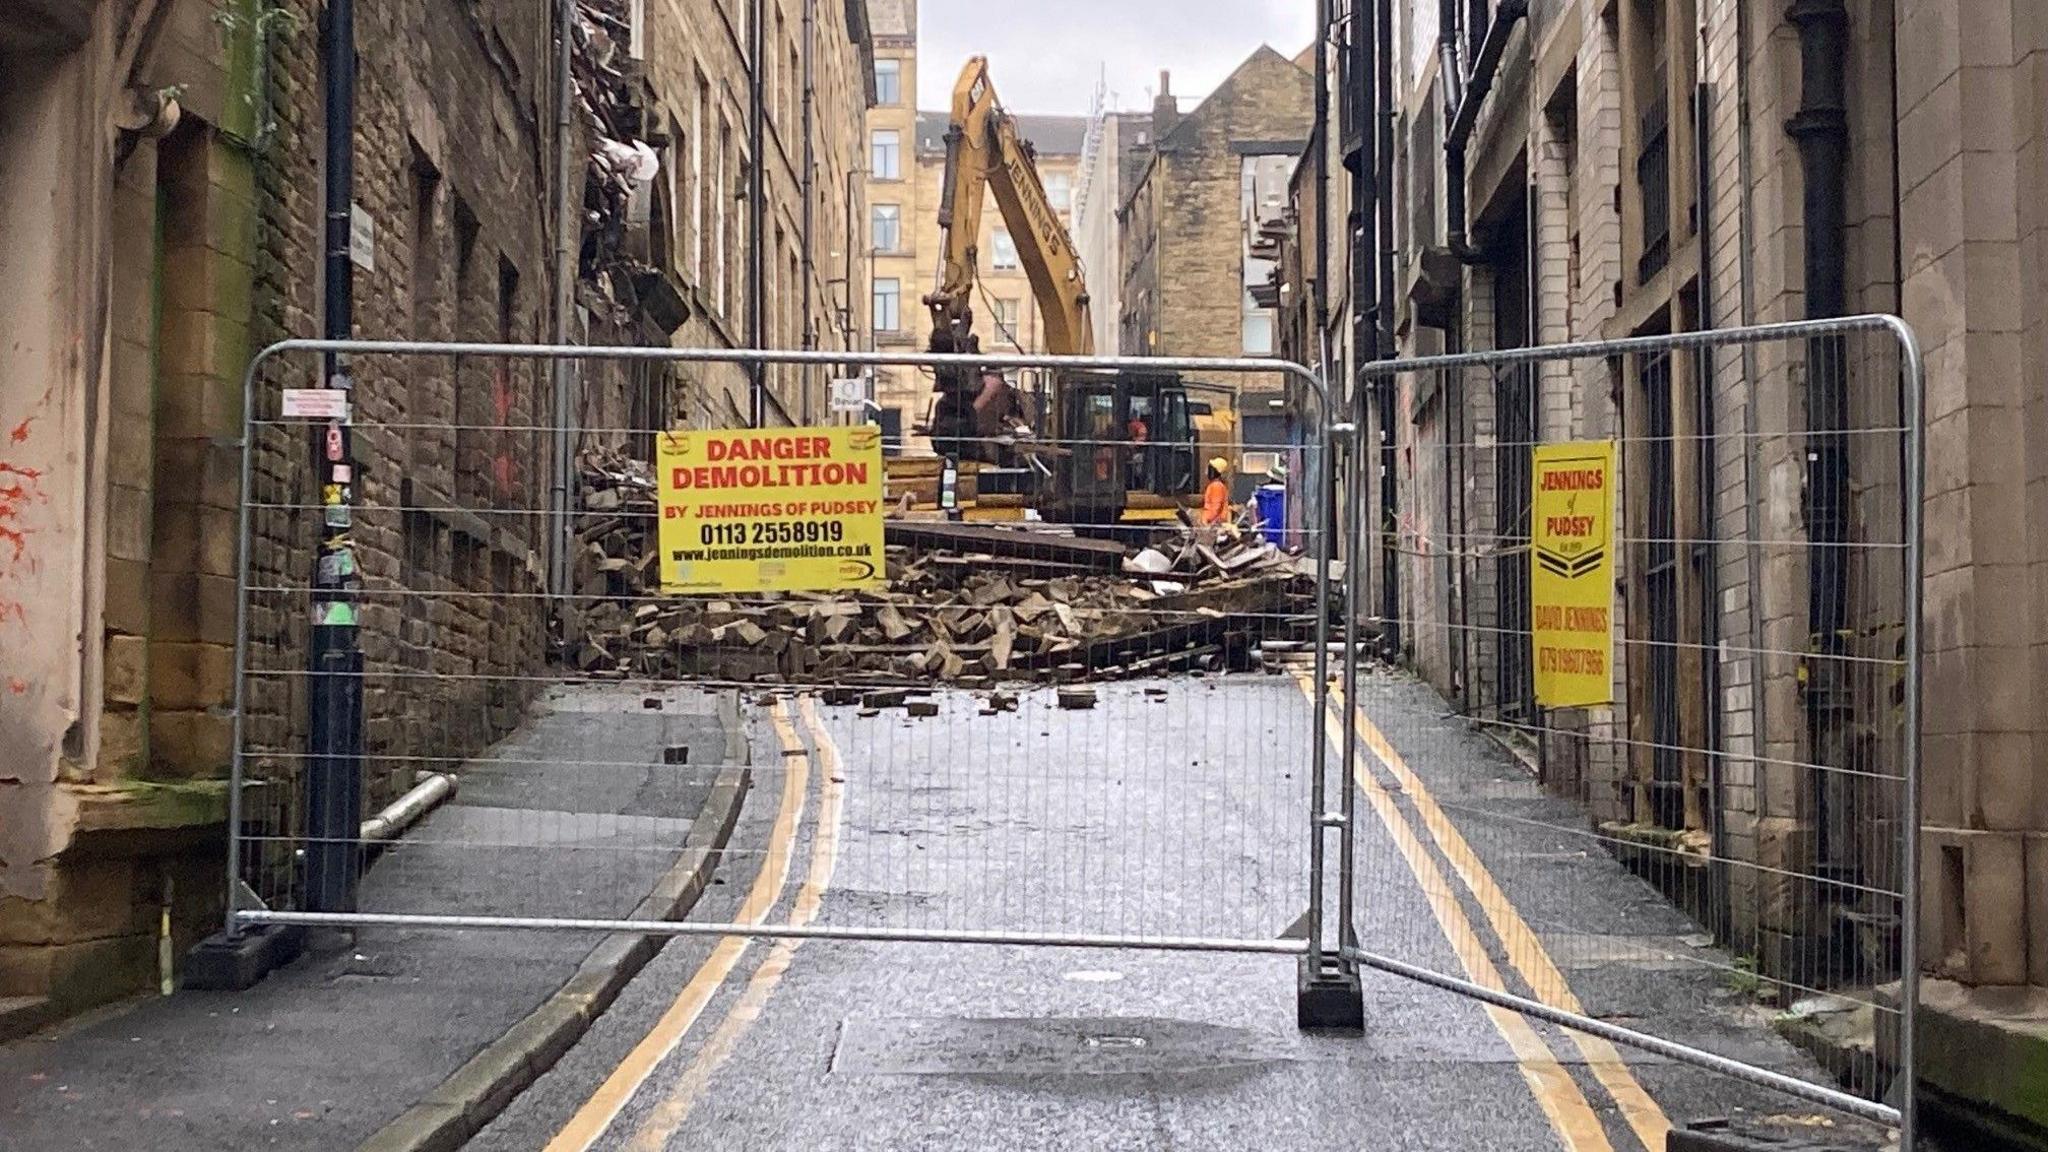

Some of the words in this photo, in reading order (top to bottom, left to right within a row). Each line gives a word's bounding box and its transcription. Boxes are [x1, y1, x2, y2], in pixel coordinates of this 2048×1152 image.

[1008, 158, 1061, 256] JENNINGS
[707, 437, 831, 461] DANGER
[672, 463, 868, 489] DEMOLITION
[1541, 469, 1603, 491] JENNINGS
[665, 506, 689, 519] BY
[695, 503, 781, 518] JENNINGS
[786, 502, 807, 516] OF
[811, 500, 878, 515] PUDSEY
[701, 523, 747, 545] 0113
[752, 520, 843, 543] 2558919
[1547, 516, 1595, 537] PUDSEY
[672, 543, 872, 562] www.jenningsdemolition.co.uk
[1535, 605, 1562, 631] DAVID
[1565, 606, 1608, 633] JENNINGS
